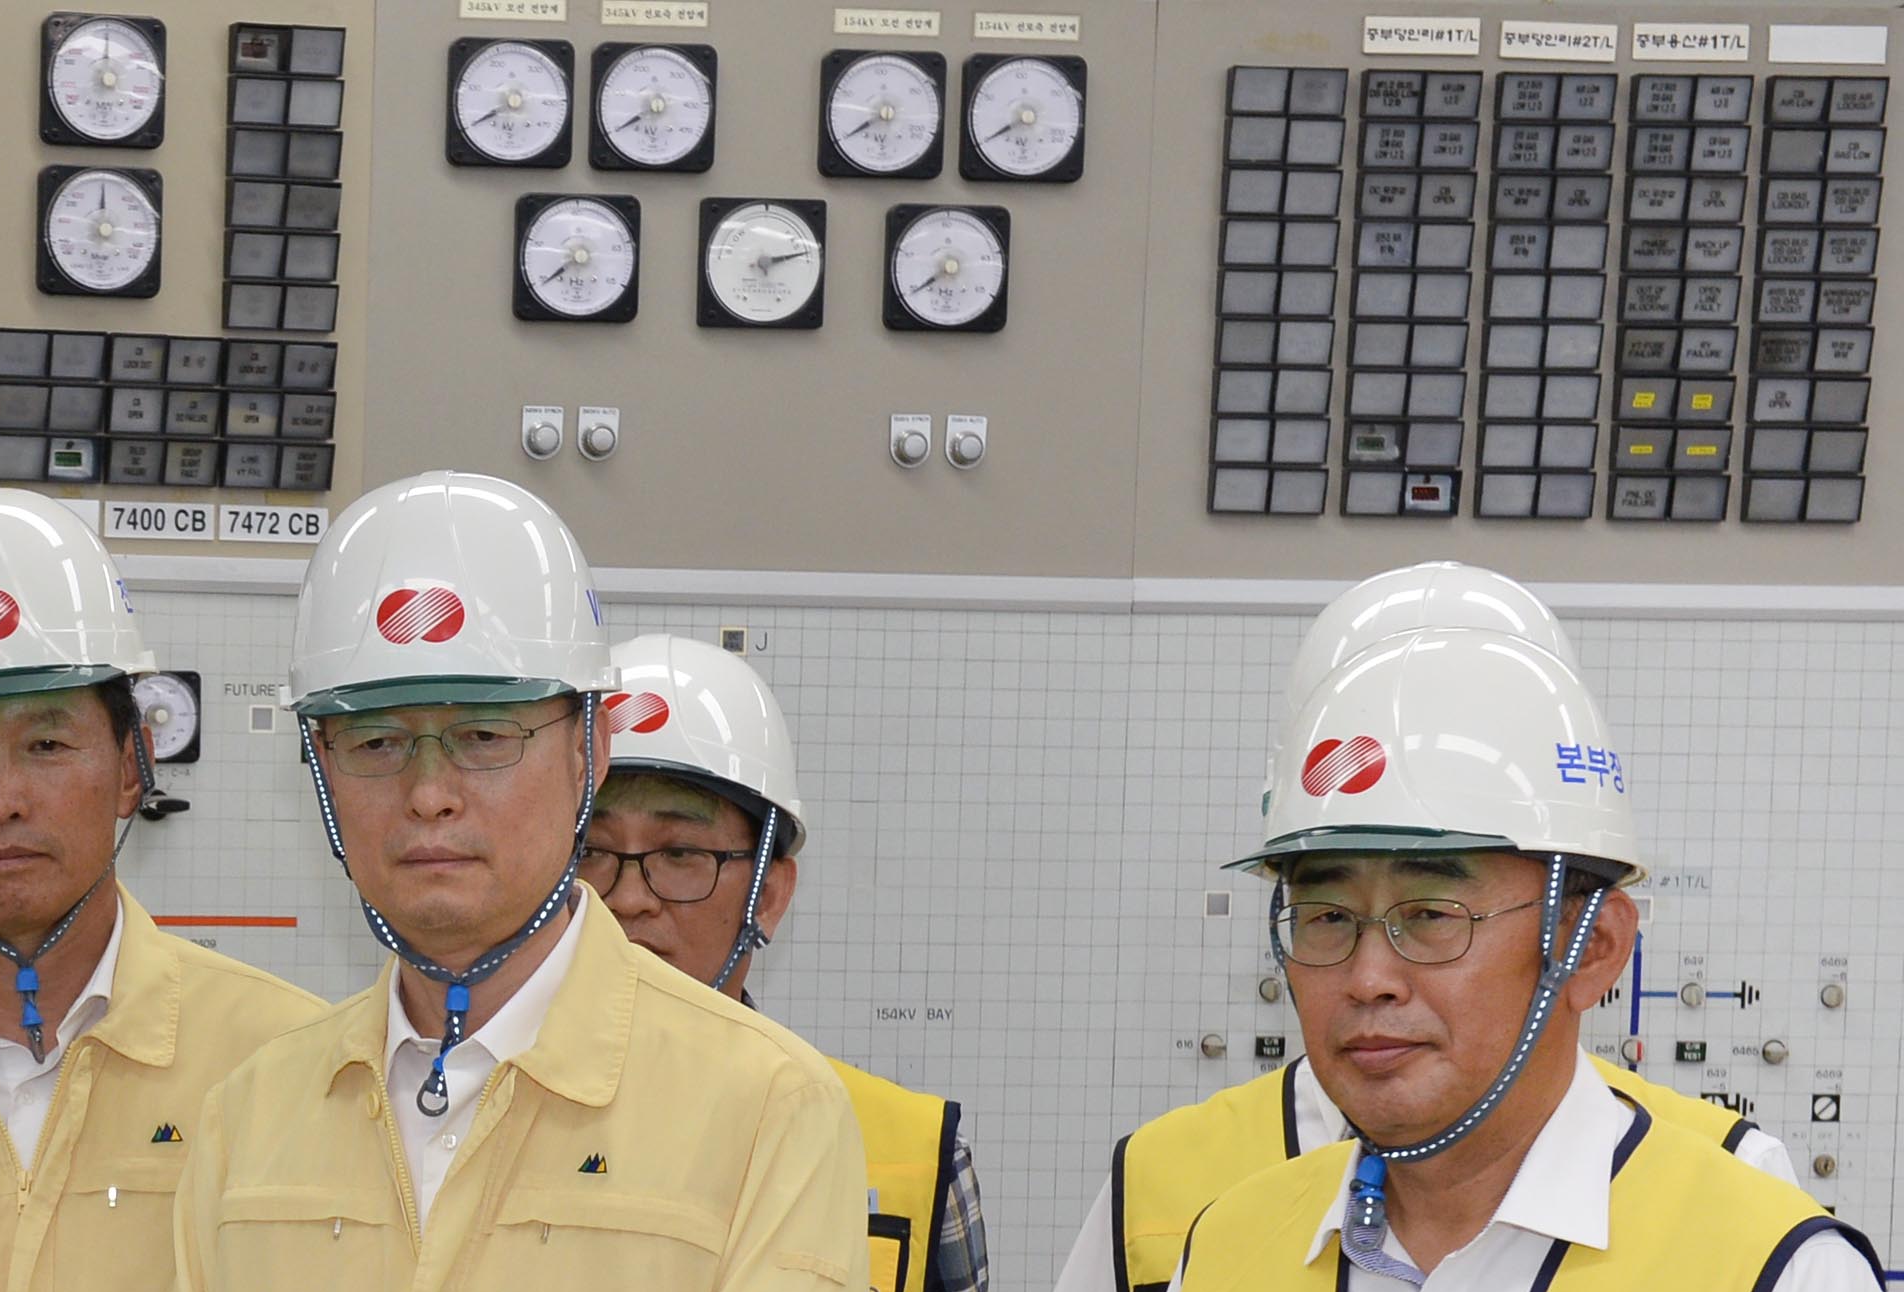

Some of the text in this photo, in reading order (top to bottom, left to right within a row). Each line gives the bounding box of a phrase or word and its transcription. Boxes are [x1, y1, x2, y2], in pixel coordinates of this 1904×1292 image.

[113, 507, 207, 532] 7400 CB
[228, 511, 320, 535] 7472 CB
[755, 632, 768, 652] J
[224, 683, 276, 697] FUTURE
[1556, 742, 1625, 794] 본부장
[876, 1006, 954, 1021] 154KV BAY
